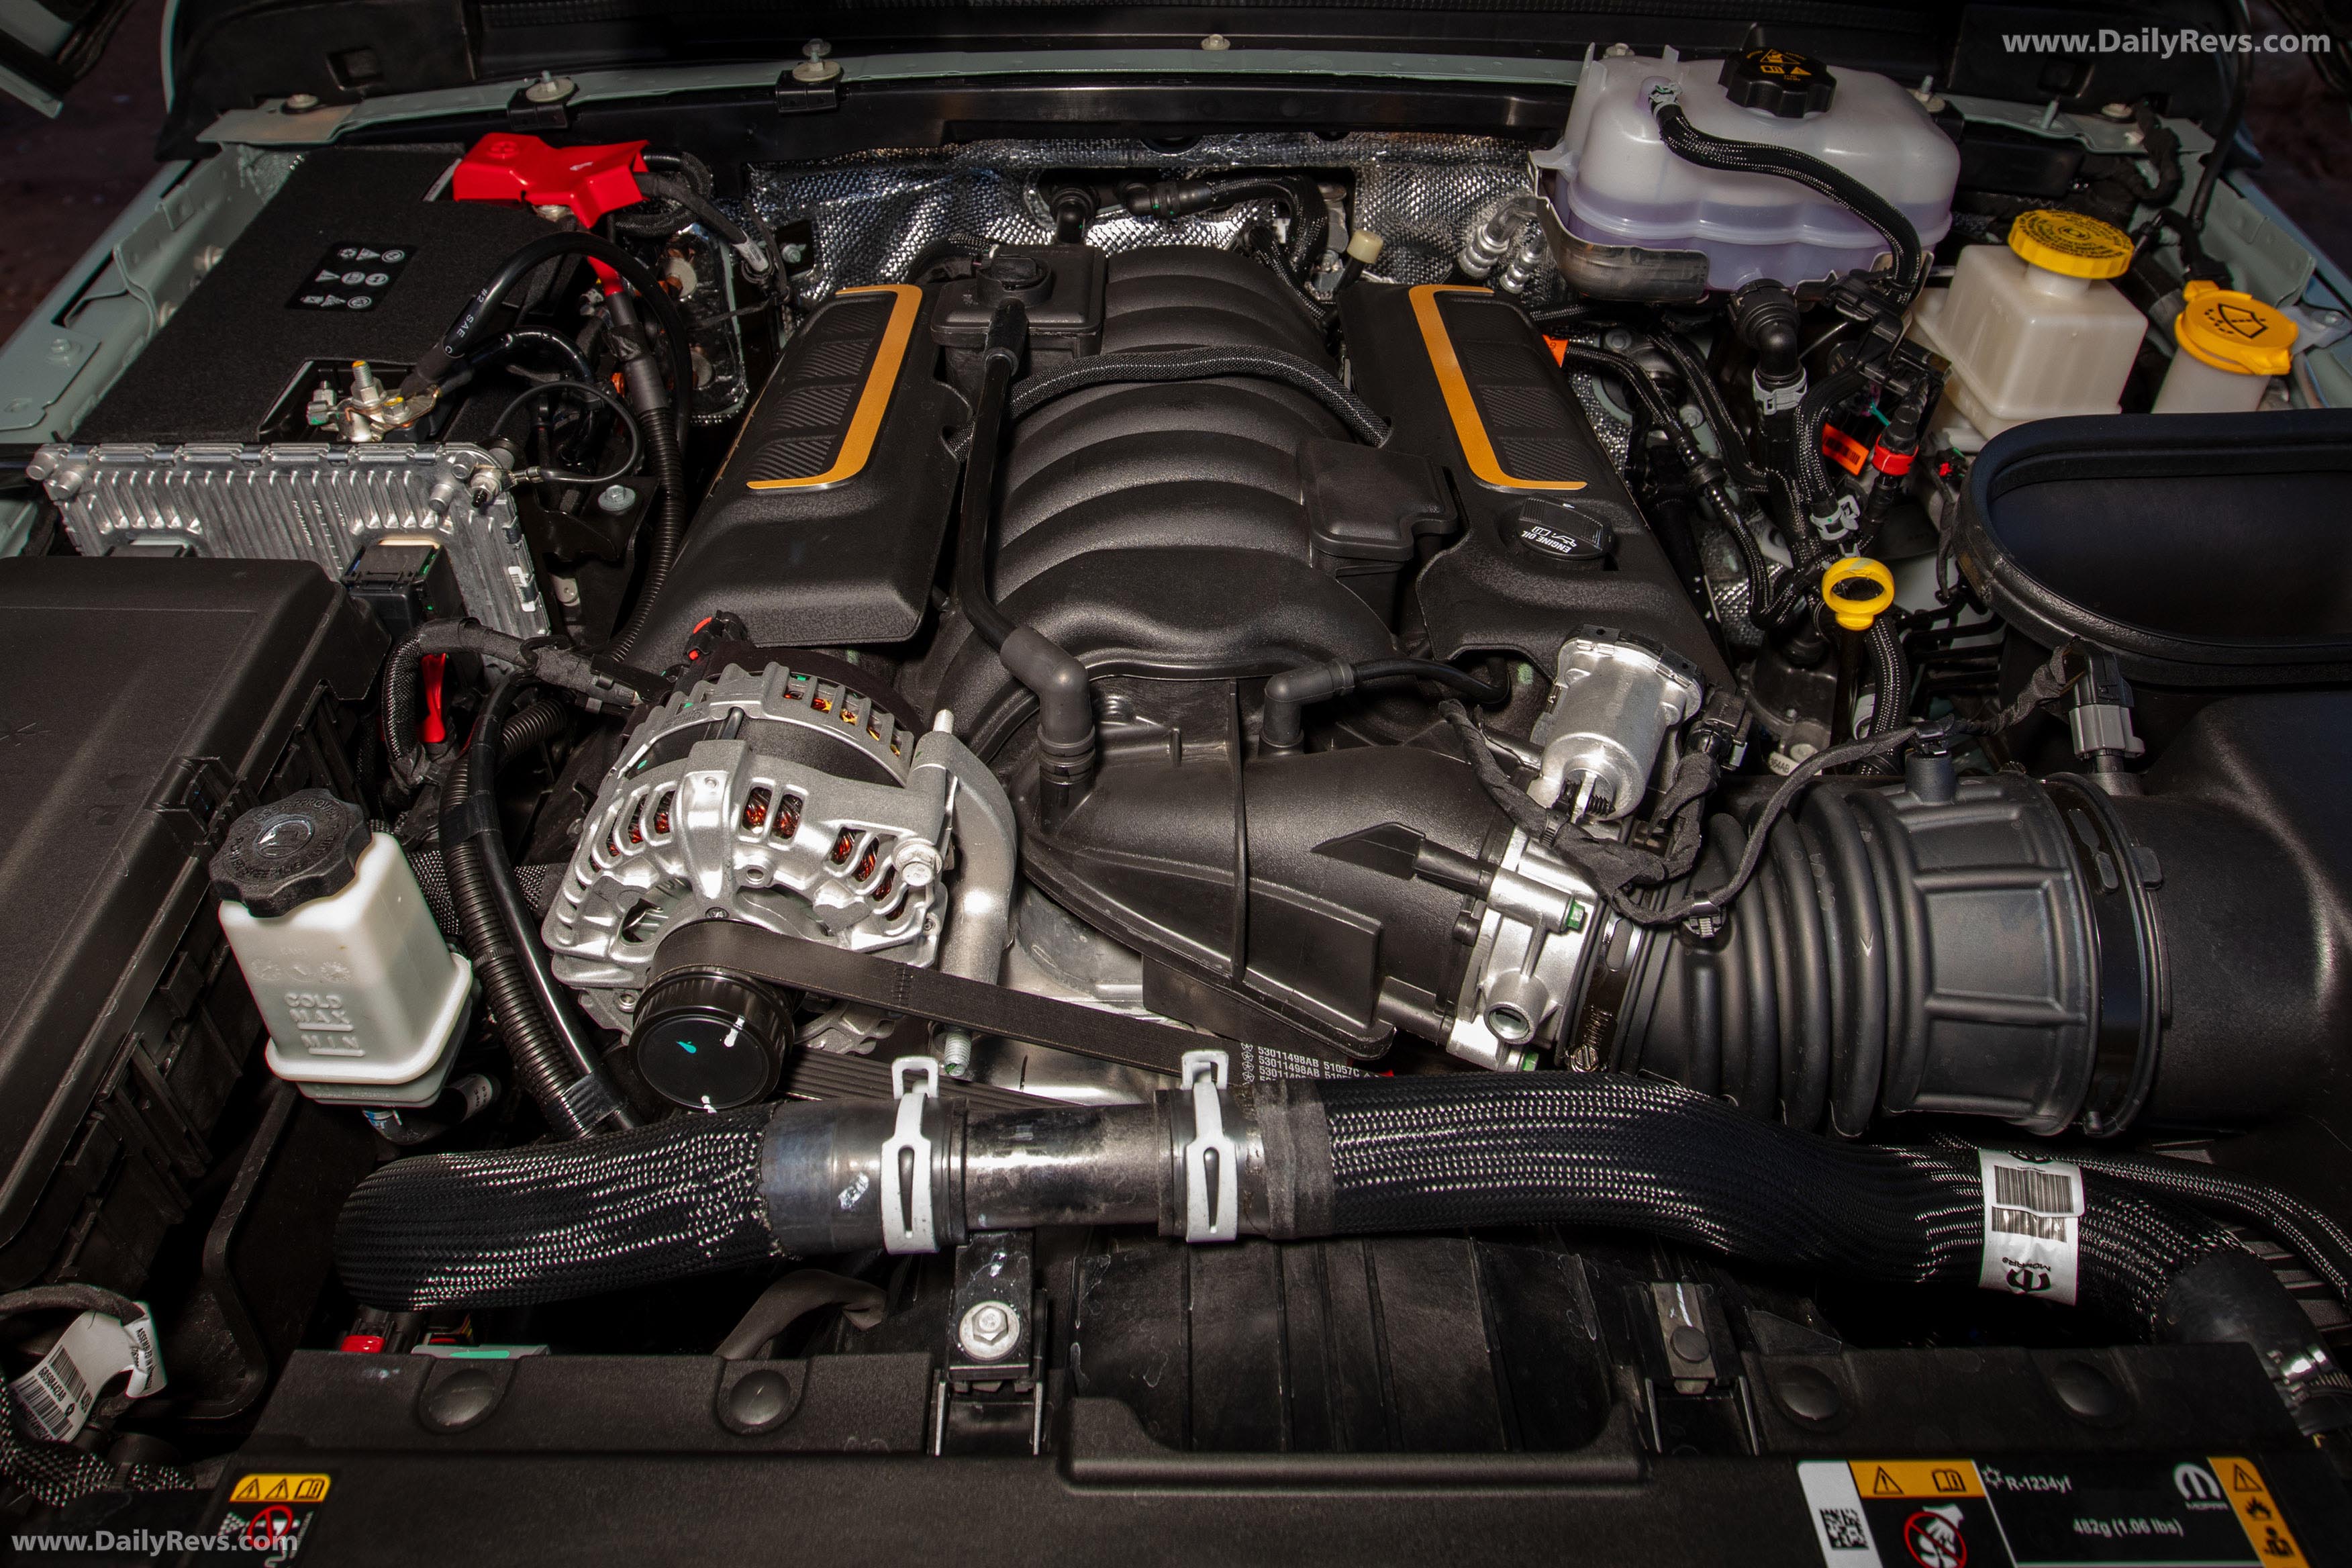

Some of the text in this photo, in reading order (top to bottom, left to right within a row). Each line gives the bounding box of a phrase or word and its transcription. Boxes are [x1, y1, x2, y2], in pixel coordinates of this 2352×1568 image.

[456, 313, 475, 338] SAE
[1521, 530, 1572, 554] ENGINE OIL
[285, 992, 343, 1009] COLD
[289, 1008, 350, 1024] MAX
[300, 1034, 360, 1049] MIN
[1258, 1046, 1319, 1068] 53011498AB
[136, 1327, 152, 1359] ASSEMBLED
[2006, 1475, 2072, 1493] R-1234yf
[2073, 1518, 2184, 1538] 482g (1.06 lbs)
